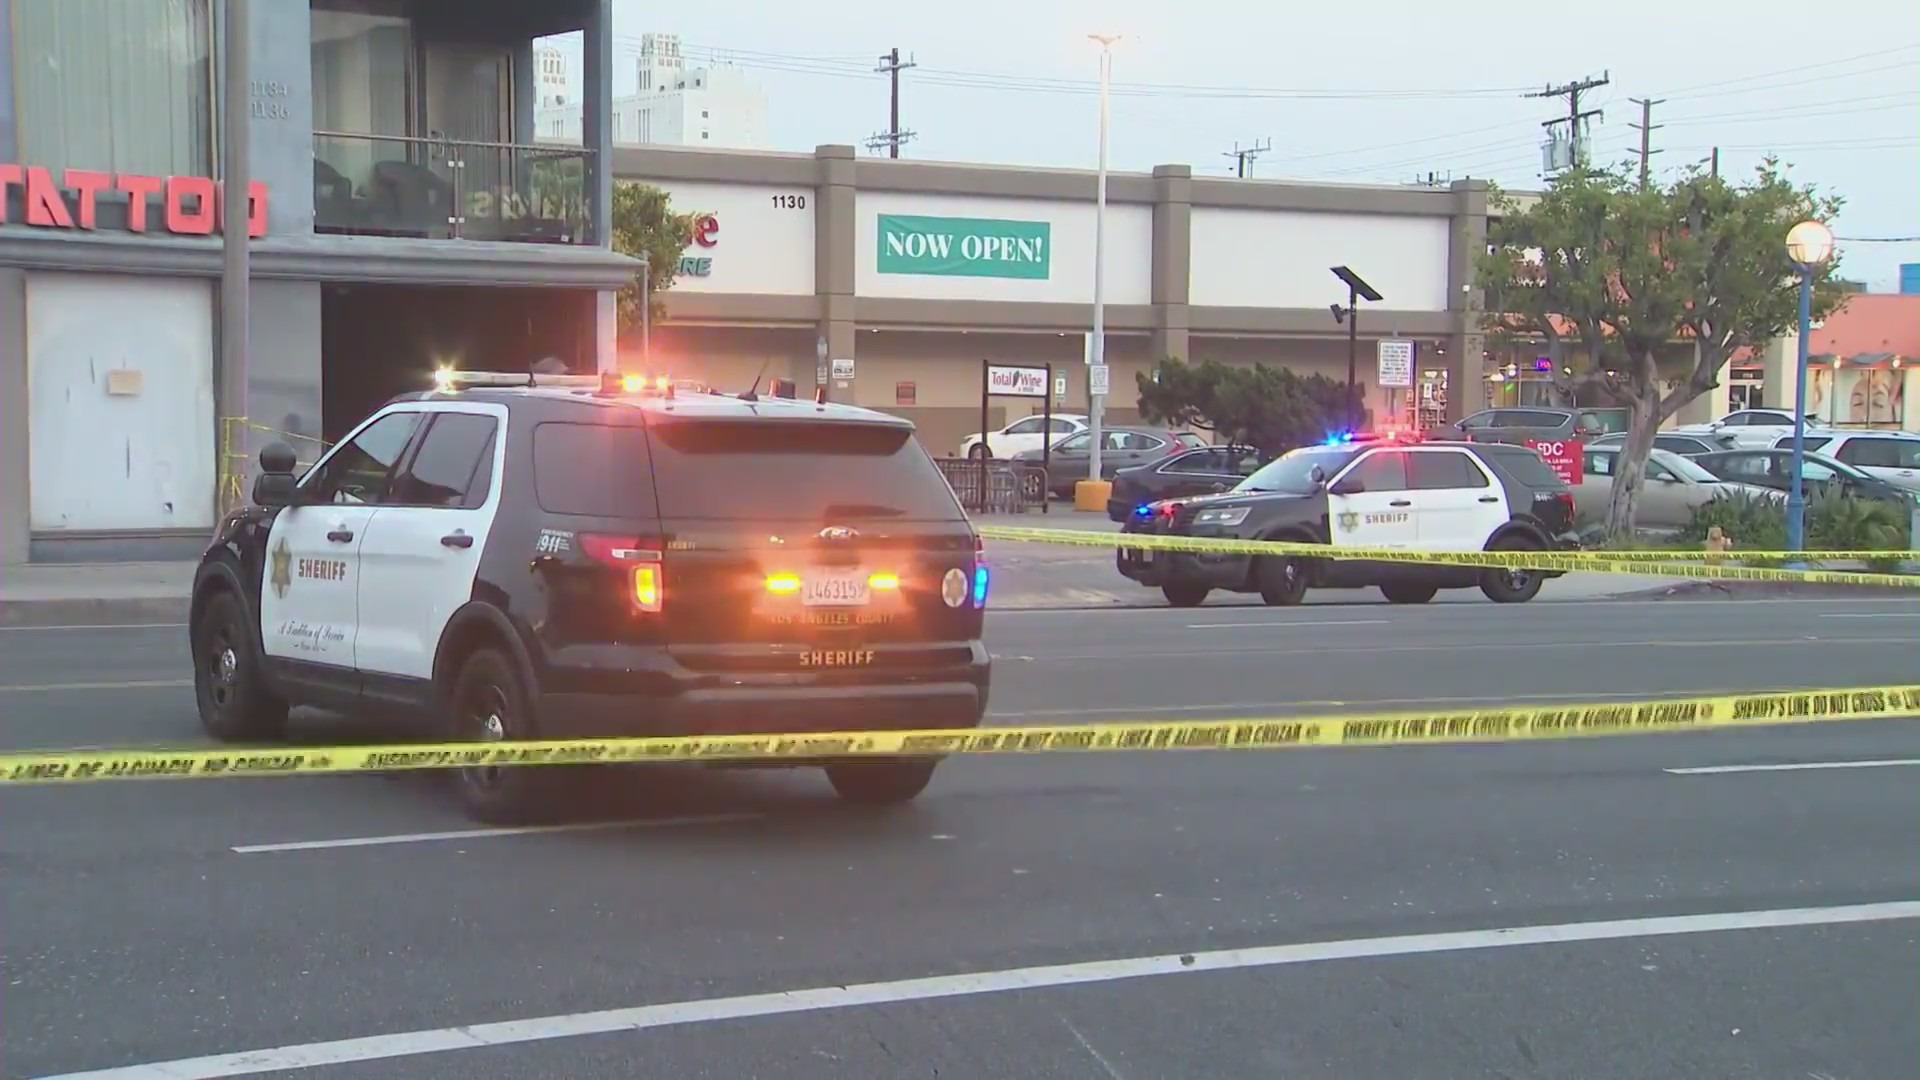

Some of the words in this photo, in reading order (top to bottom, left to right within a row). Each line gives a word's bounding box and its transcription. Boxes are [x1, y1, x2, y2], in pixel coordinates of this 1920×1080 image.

[772, 195, 805, 209] 1130
[886, 231, 953, 259] NOW
[960, 234, 1043, 263] OPEN!
[992, 371, 1012, 386] Total
[1019, 374, 1043, 388] Wine
[1365, 513, 1409, 524] SHERIFF
[540, 534, 561, 553] 911
[298, 558, 346, 581] SHERIFF
[800, 651, 874, 665] SHERIFF
[1788, 696, 1810, 715] LINE
[1813, 695, 1827, 714] DO
[1829, 694, 1848, 714] NOT
[1851, 691, 1885, 712] CROSS
